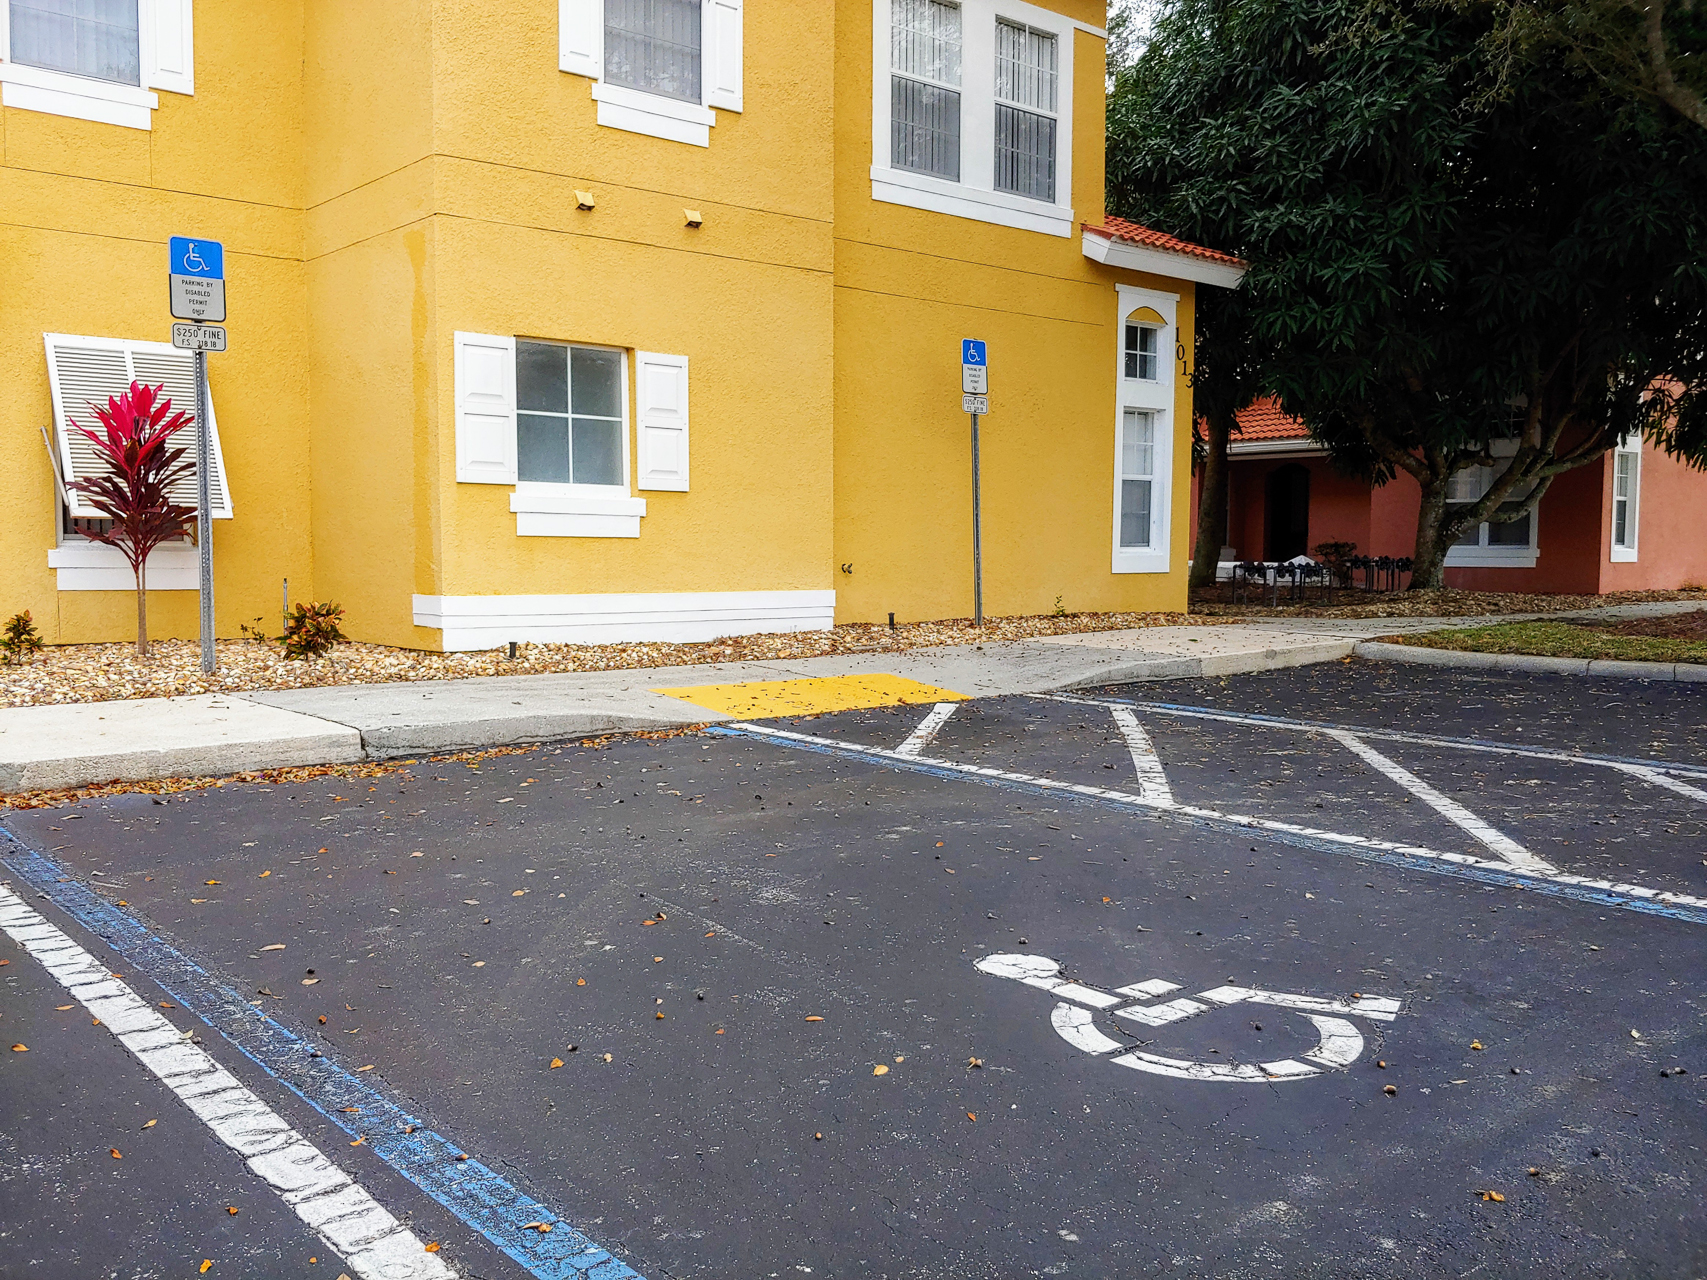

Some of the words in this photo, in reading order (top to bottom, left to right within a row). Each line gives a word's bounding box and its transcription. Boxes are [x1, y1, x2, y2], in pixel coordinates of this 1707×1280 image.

[181, 279, 204, 287] PARKING
[185, 289, 211, 297] DISABLED
[176, 327, 199, 338] $250
[203, 329, 222, 340] FINE
[1176, 326, 1194, 389] 1013
